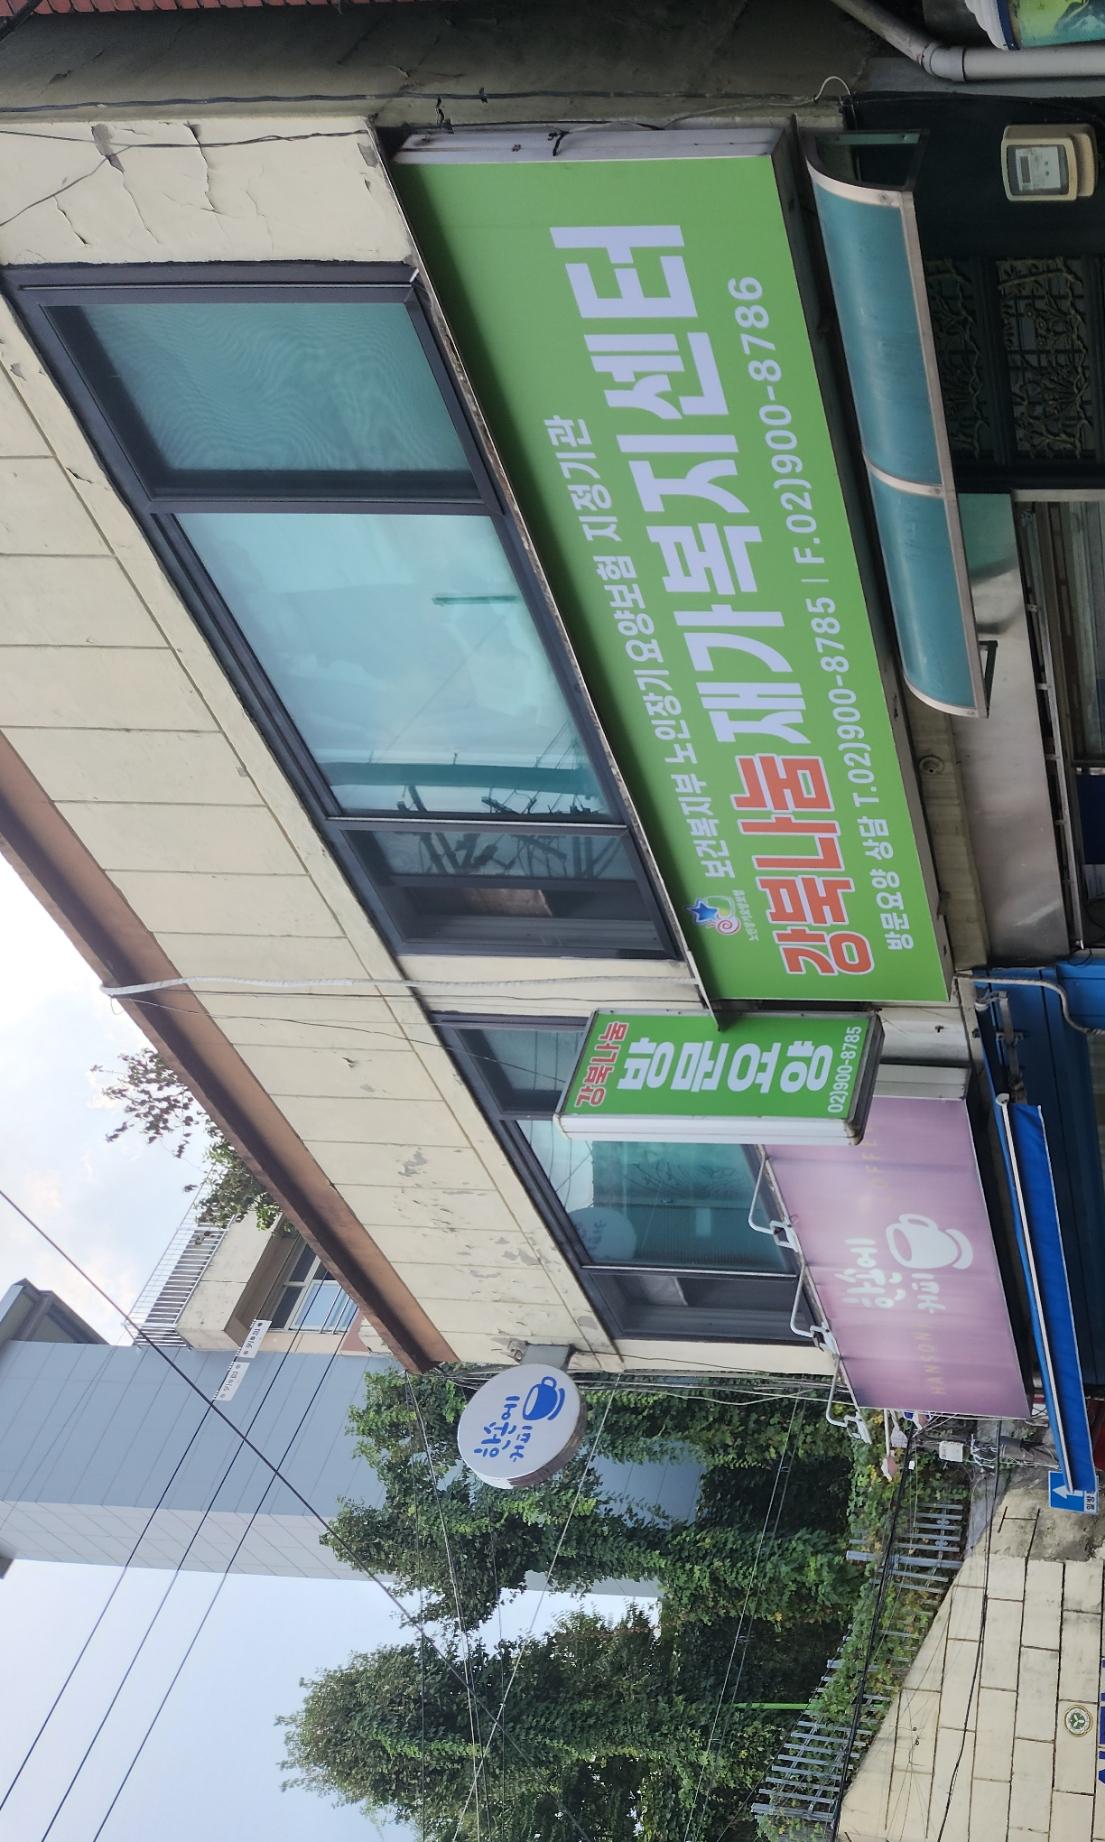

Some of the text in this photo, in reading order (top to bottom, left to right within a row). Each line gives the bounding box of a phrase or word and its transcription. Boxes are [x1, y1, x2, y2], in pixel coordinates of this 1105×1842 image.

[544, 415, 623, 542] 지정기관
[549, 225, 875, 975] 강북나눔 재가복지센터
[727, 276, 914, 950] 방문요양 상담 T.02)900-8785 F.02)900-8786
[670, 774, 736, 879] 보건복지부
[574, 1021, 629, 1107] 강북나눔
[616, 1037, 833, 1094] 방문요양
[827, 1025, 862, 1113] 02)900-8785
[911, 1273, 946, 1314] 커피
[509, 1425, 533, 1462] 커피
